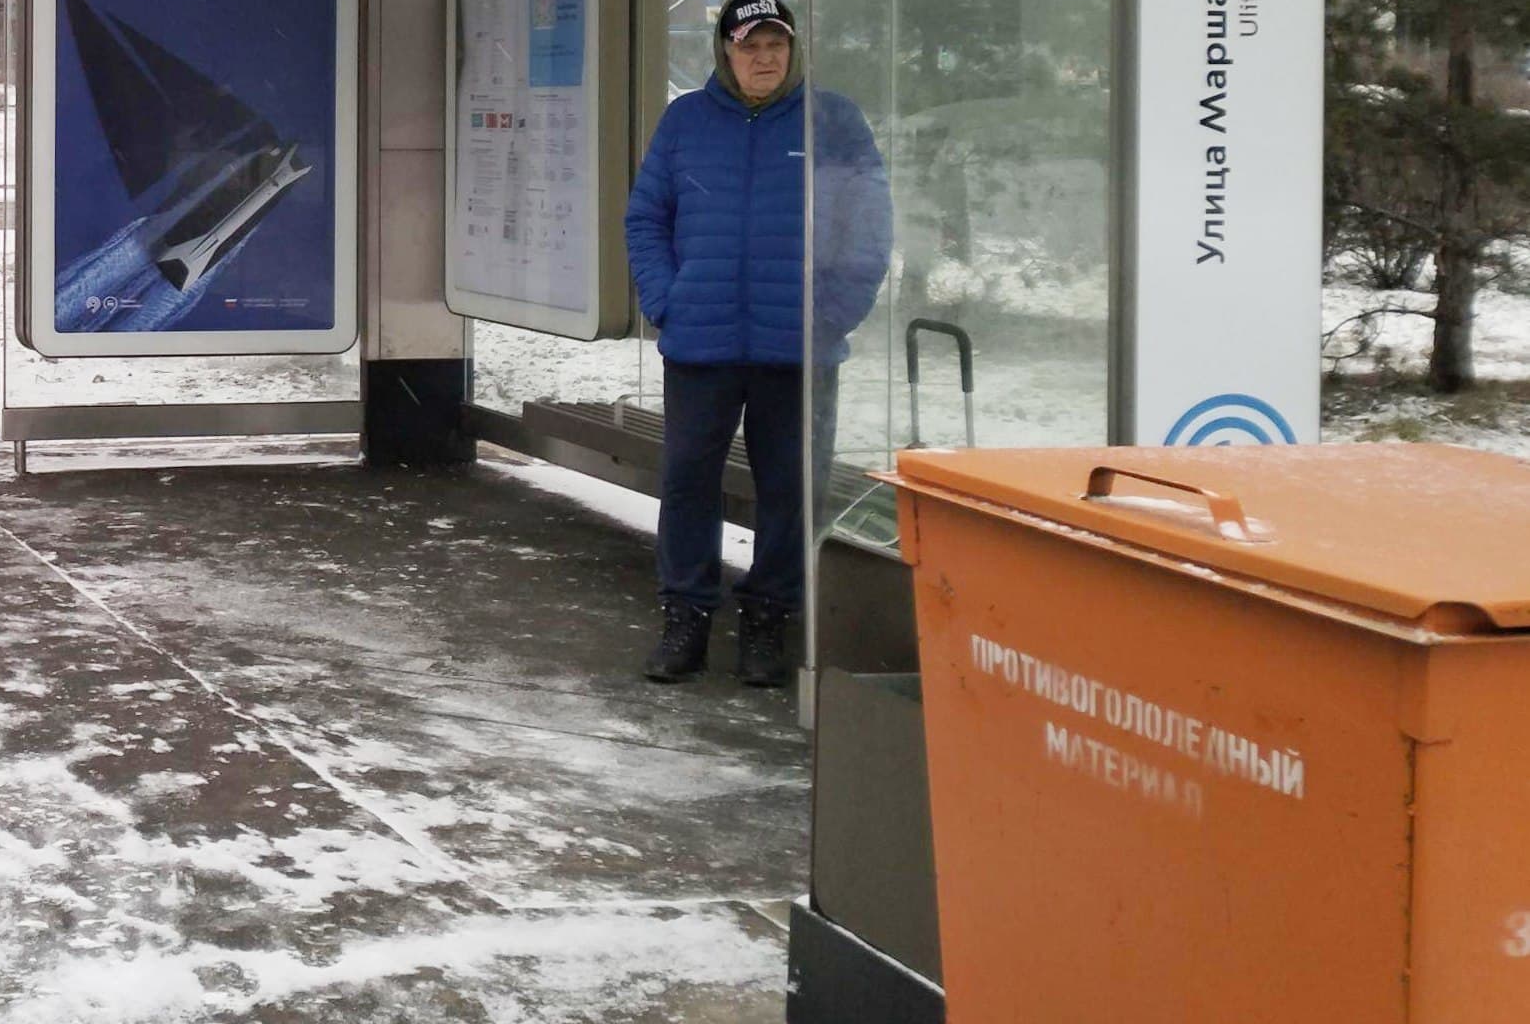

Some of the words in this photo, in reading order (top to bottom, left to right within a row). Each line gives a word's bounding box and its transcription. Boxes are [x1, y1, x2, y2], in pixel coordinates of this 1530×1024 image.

[735, 0, 780, 20] RUSSIA
[1196, 145, 1231, 265] Улица
[970, 633, 1305, 800] ПРОТИВОГОЛОЛЕДНЫЙ
